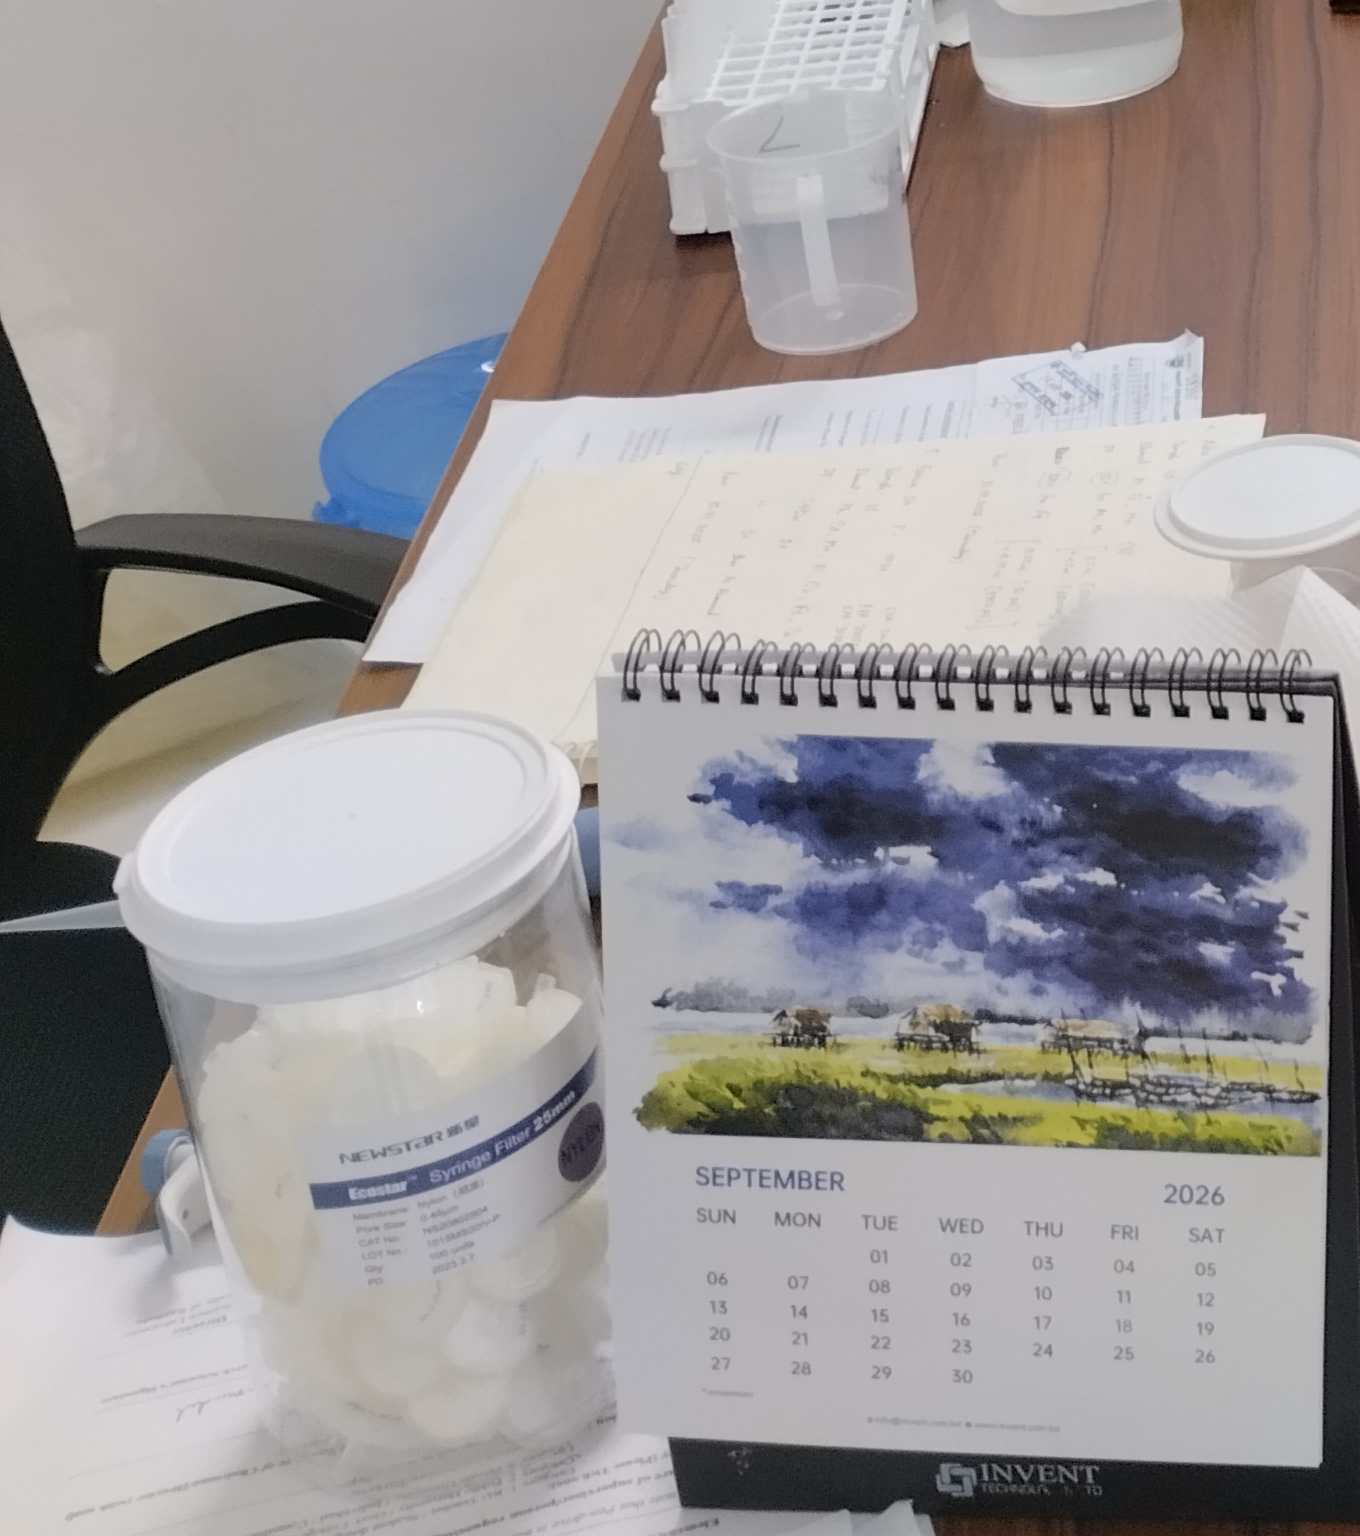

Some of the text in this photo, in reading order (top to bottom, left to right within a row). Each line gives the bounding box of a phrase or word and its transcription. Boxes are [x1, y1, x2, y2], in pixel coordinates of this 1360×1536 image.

[429, 1150, 492, 1184] Syringe
[494, 1126, 531, 1158] Filter
[532, 1090, 577, 1132] 25mm
[696, 1166, 845, 1191] SEPTEMBER
[1164, 1184, 1225, 1206] 2026
[697, 1208, 1224, 1243] SUN MON TUE WED THU FRI SAT
[870, 1249, 1216, 1276] 01 02 03 04 05
[707, 1271, 1214, 1307] 06 07 08 09 10 11 12
[710, 1301, 1214, 1335] 13 14 15 16 17 18 19
[710, 1327, 1215, 1363] 20 21 22 23 24 25 26
[712, 1357, 973, 1383] 27 28 29 30
[981, 1464, 1100, 1484] INVENT
